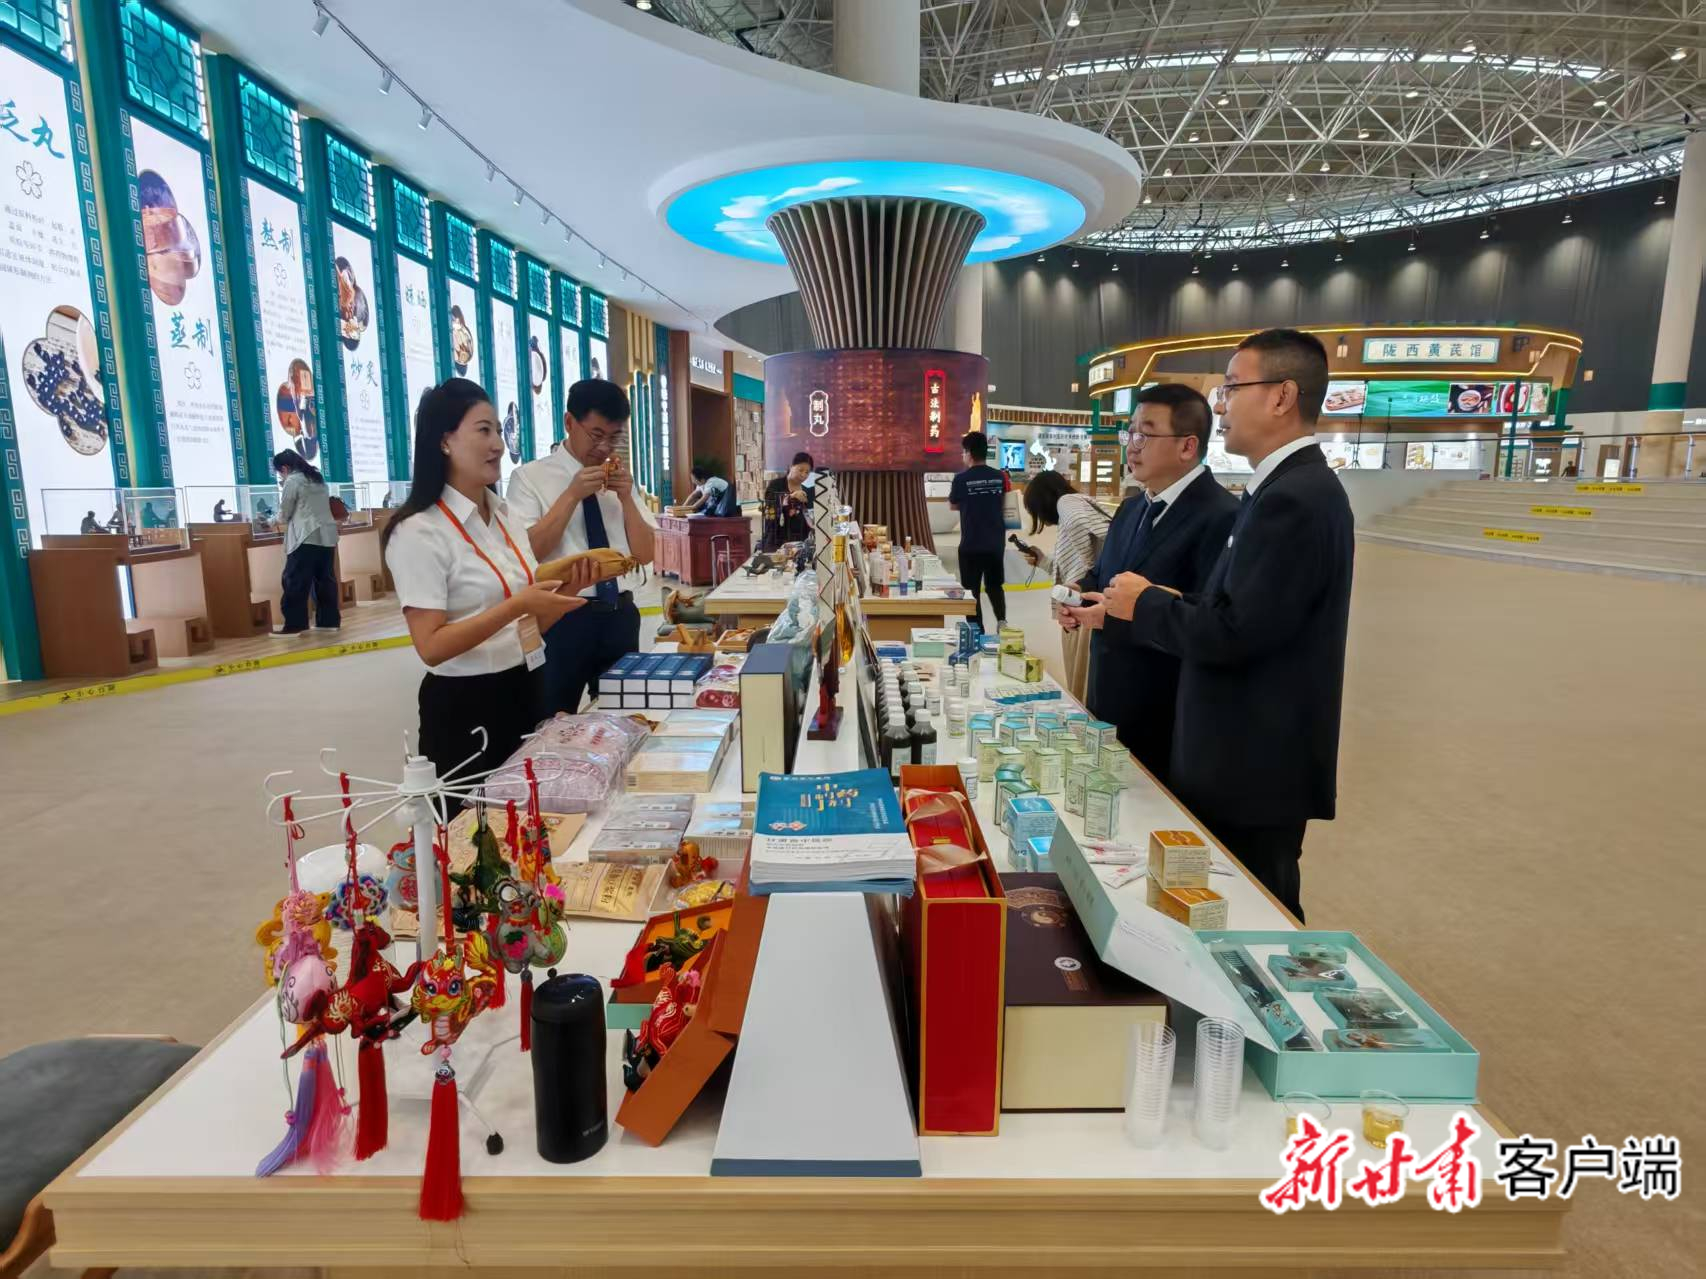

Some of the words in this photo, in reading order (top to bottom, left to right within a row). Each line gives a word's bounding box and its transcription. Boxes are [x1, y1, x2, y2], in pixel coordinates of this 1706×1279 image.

[170, 312, 214, 357] 蒸制
[1382, 343, 1485, 358] 陇西黄芪馆
[812, 399, 825, 425] 制丸
[929, 383, 941, 438] 古法制药
